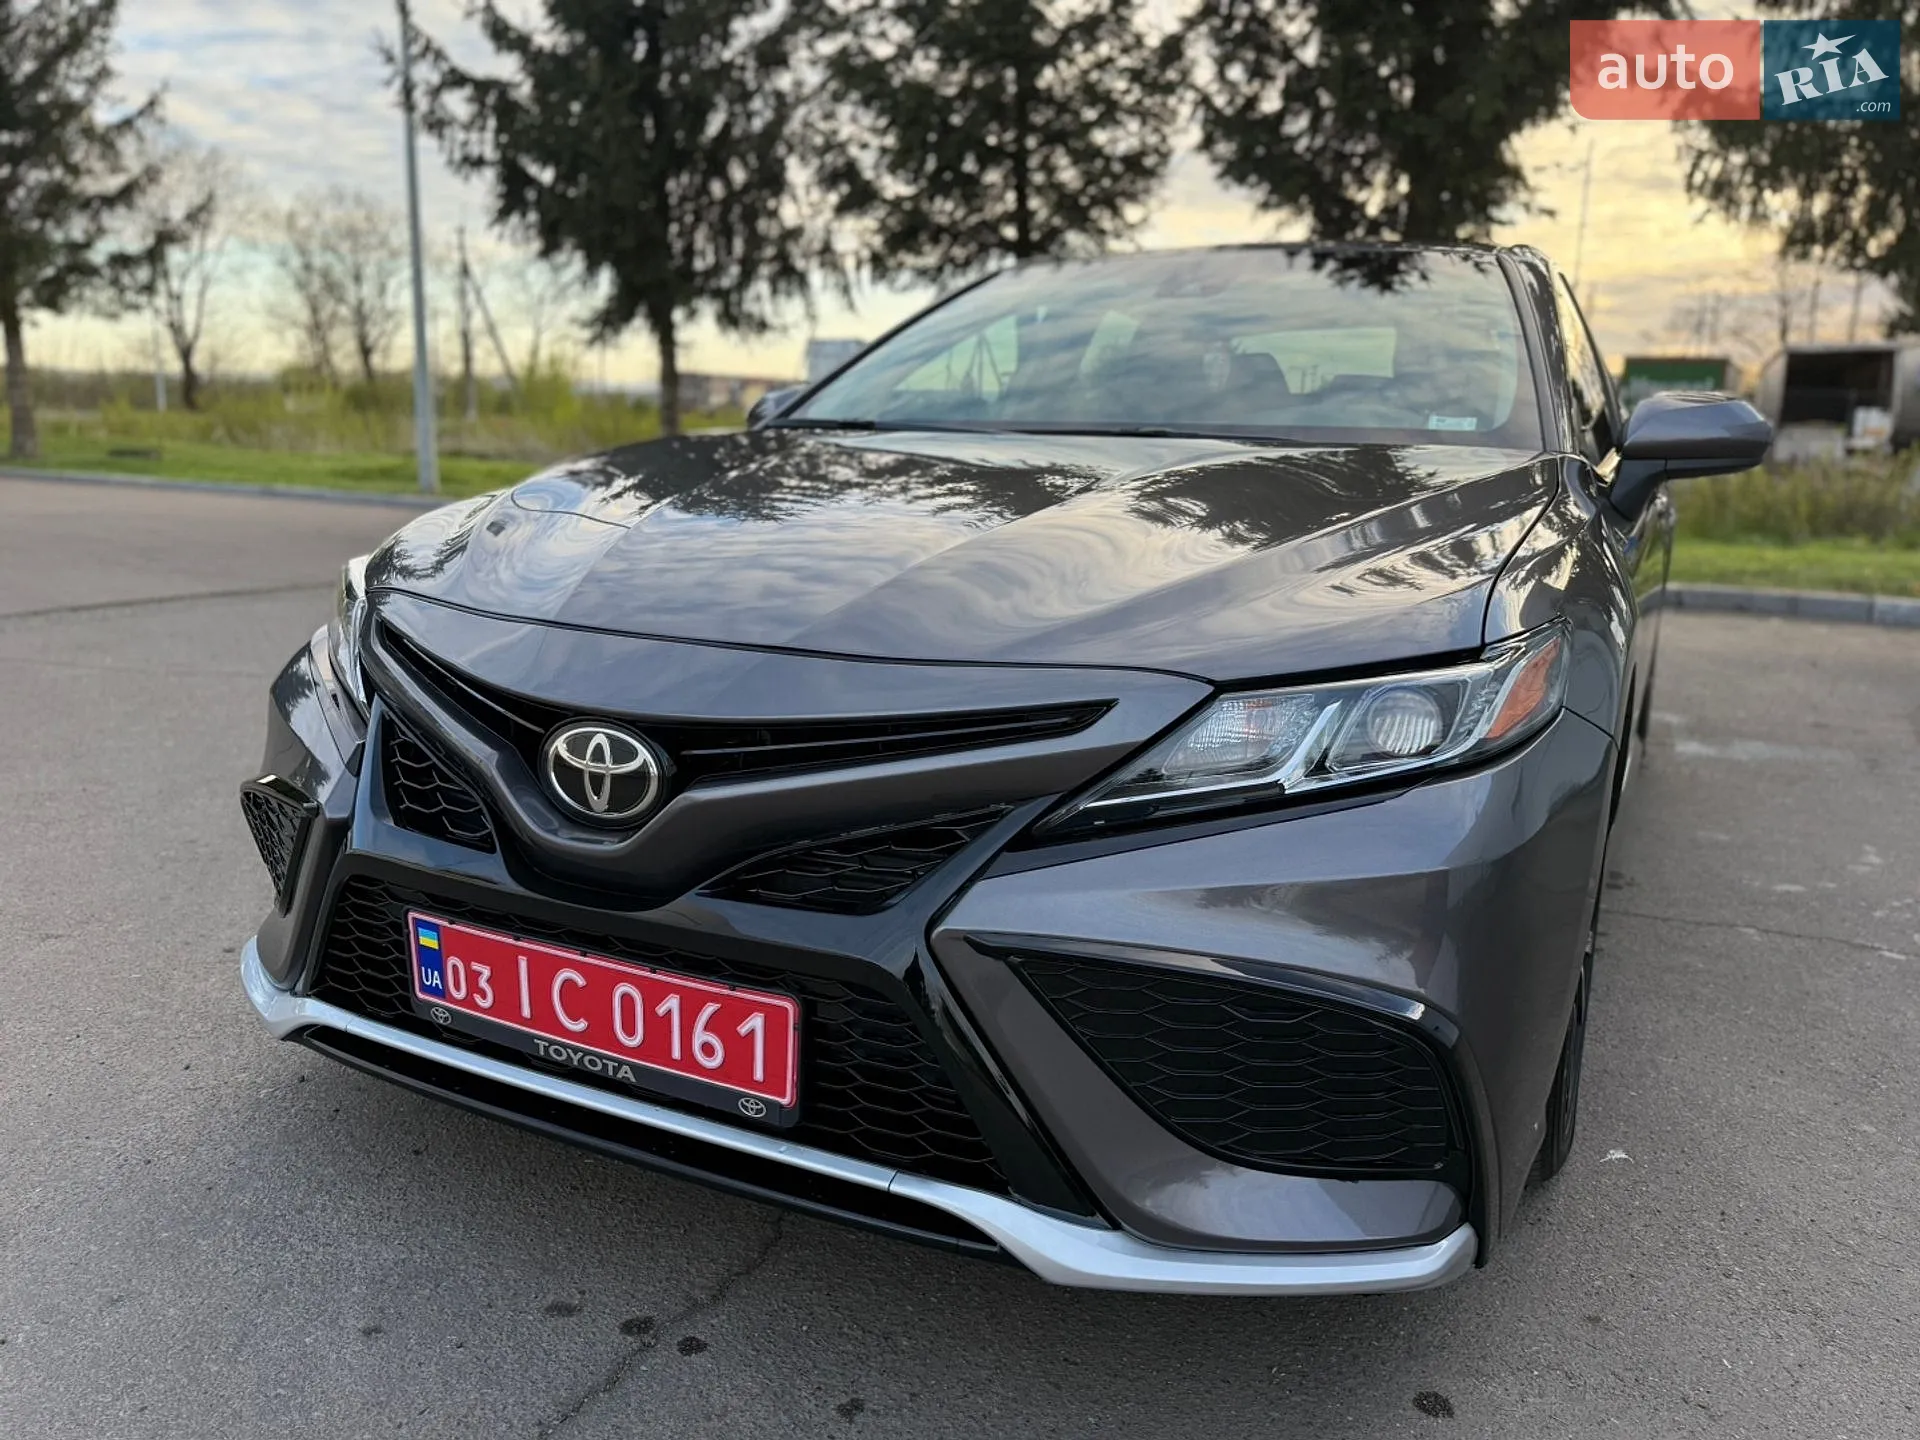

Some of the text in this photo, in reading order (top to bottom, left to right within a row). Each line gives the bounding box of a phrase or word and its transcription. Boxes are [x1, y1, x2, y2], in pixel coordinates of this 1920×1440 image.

[421, 965, 443, 990] UA
[446, 955, 766, 1082] 03 IC 0161
[533, 1039, 637, 1083] TOYOTA
